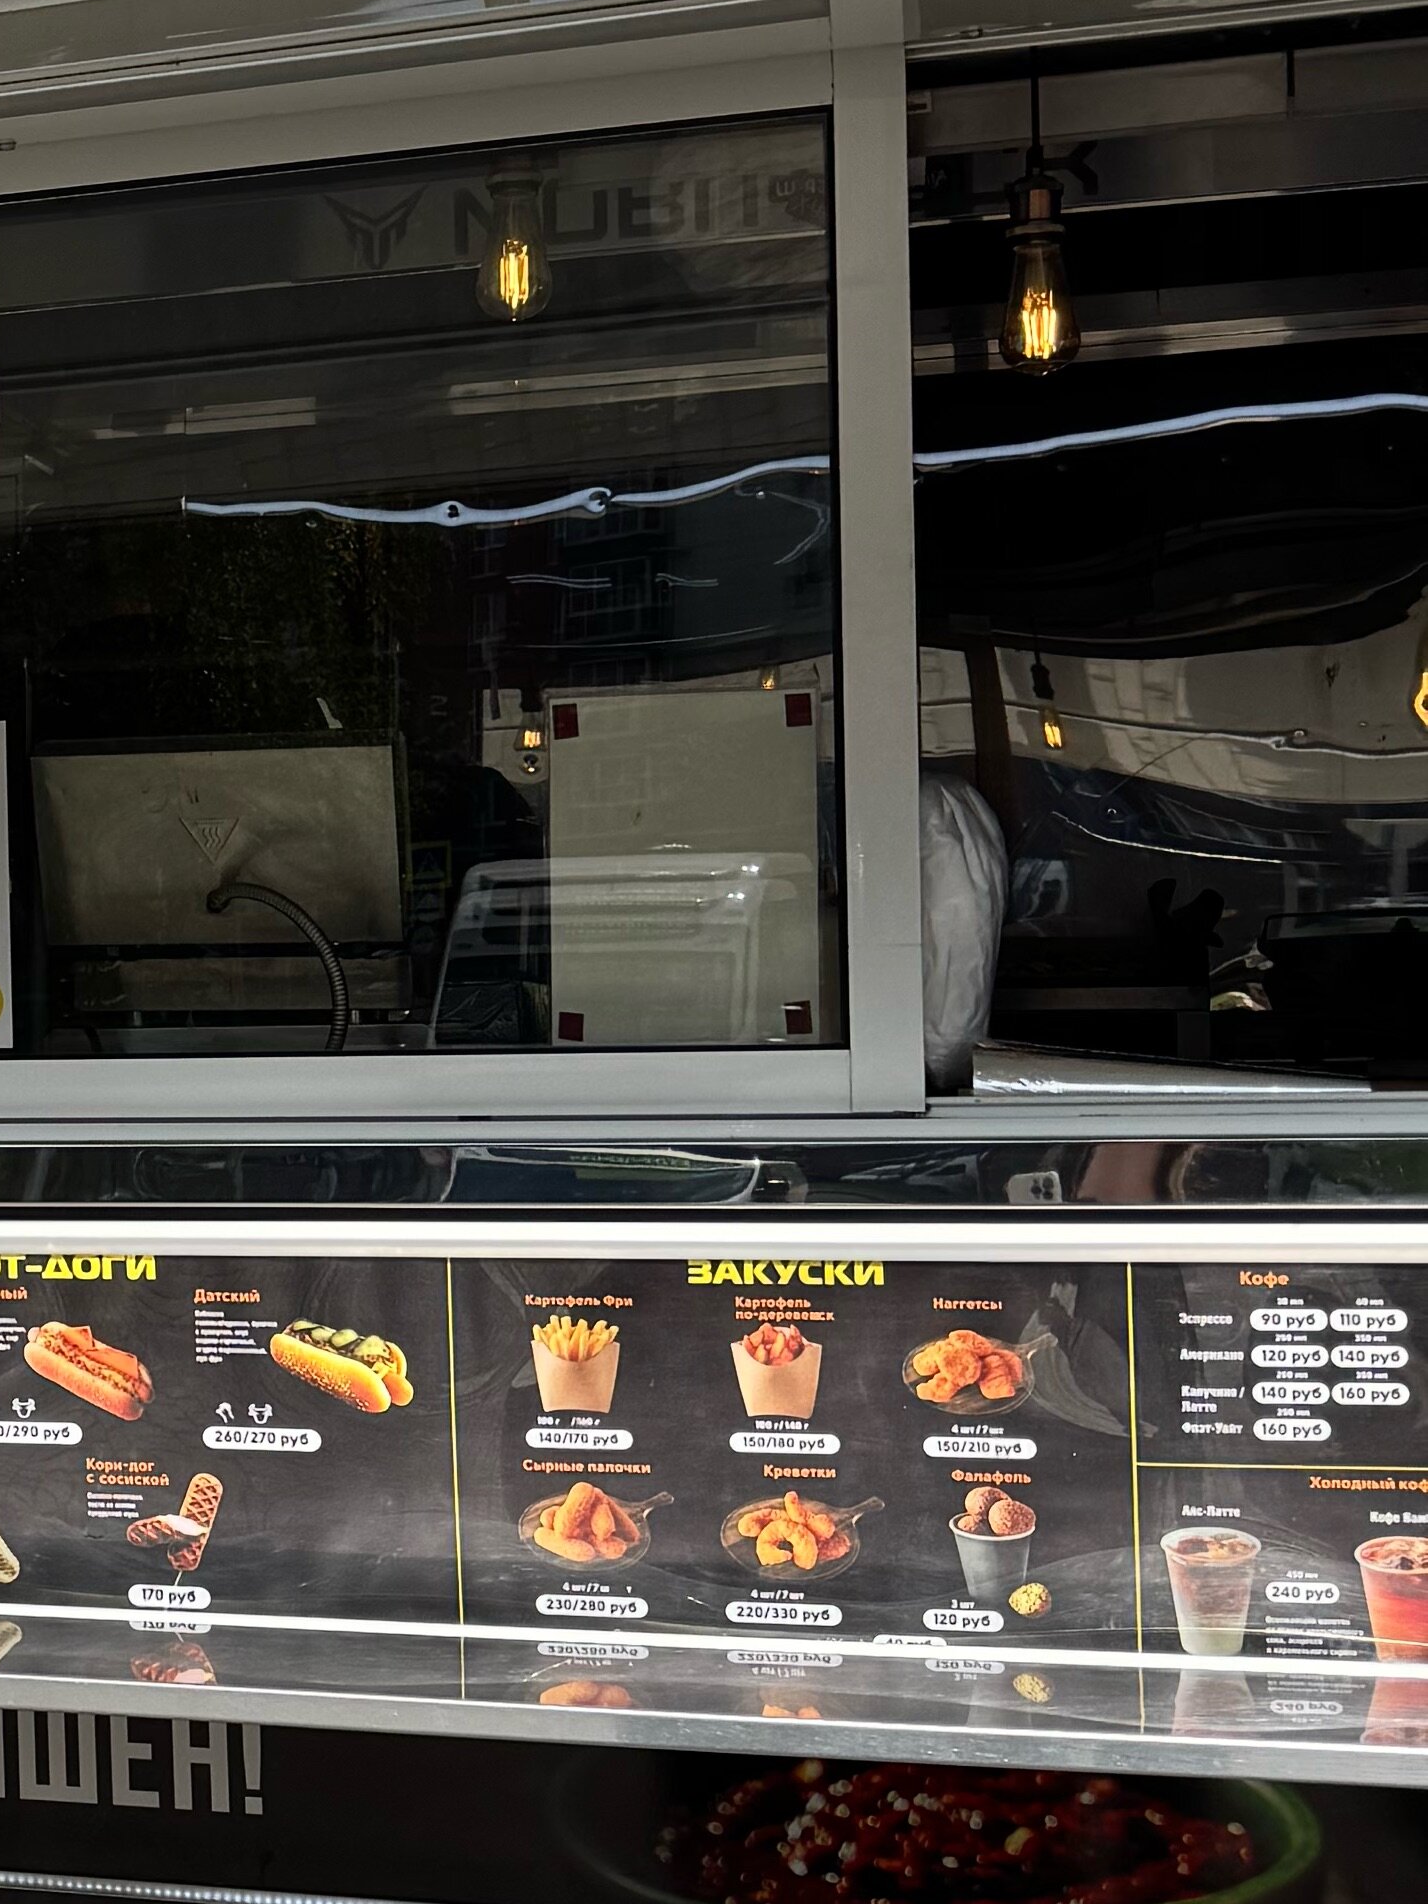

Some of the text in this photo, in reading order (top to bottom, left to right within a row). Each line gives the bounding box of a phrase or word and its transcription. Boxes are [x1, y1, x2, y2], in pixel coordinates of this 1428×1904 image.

[687, 1260, 885, 1286] ЗАКУСКИ
[1239, 1271, 1289, 1289] Кофе
[194, 1289, 260, 1304] Датский
[525, 1295, 633, 1308] Картофель Фри
[735, 1296, 811, 1310] Картофель
[933, 1297, 1003, 1310] Наггетсы
[1262, 1313, 1281, 1326] 90
[1286, 1314, 1315, 1330] руб
[1340, 1313, 1361, 1326] 110
[1367, 1314, 1396, 1331] руб
[1262, 1350, 1287, 1363] 120
[1292, 1351, 1321, 1366] руб
[1340, 1350, 1365, 1363] 140
[1371, 1351, 1400, 1367] руб
[1261, 1387, 1287, 1400] 140
[1292, 1388, 1321, 1403] руб
[1340, 1388, 1366, 1400] 160
[1371, 1388, 1401, 1404] руб
[44, 1426, 70, 1441] руб
[215, 1431, 309, 1447] 260/270 руб
[539, 1432, 618, 1447] 140/170 руб
[1262, 1423, 1287, 1436] 160
[1292, 1424, 1322, 1441] руб
[743, 1436, 825, 1450] 150/180 руб
[937, 1441, 1022, 1456] 150/210 руб
[522, 1459, 651, 1474] Сырные палочки
[763, 1465, 836, 1480] Креветки
[99, 1473, 170, 1486] сосиской
[951, 1469, 1032, 1484] Фалафель
[142, 1588, 196, 1605] 170 руб
[1272, 1586, 1334, 1602] 240 руб
[546, 1599, 637, 1615] 230/280 руб
[737, 1606, 830, 1622] 220/330 руб
[934, 1614, 990, 1629] 120 руб
